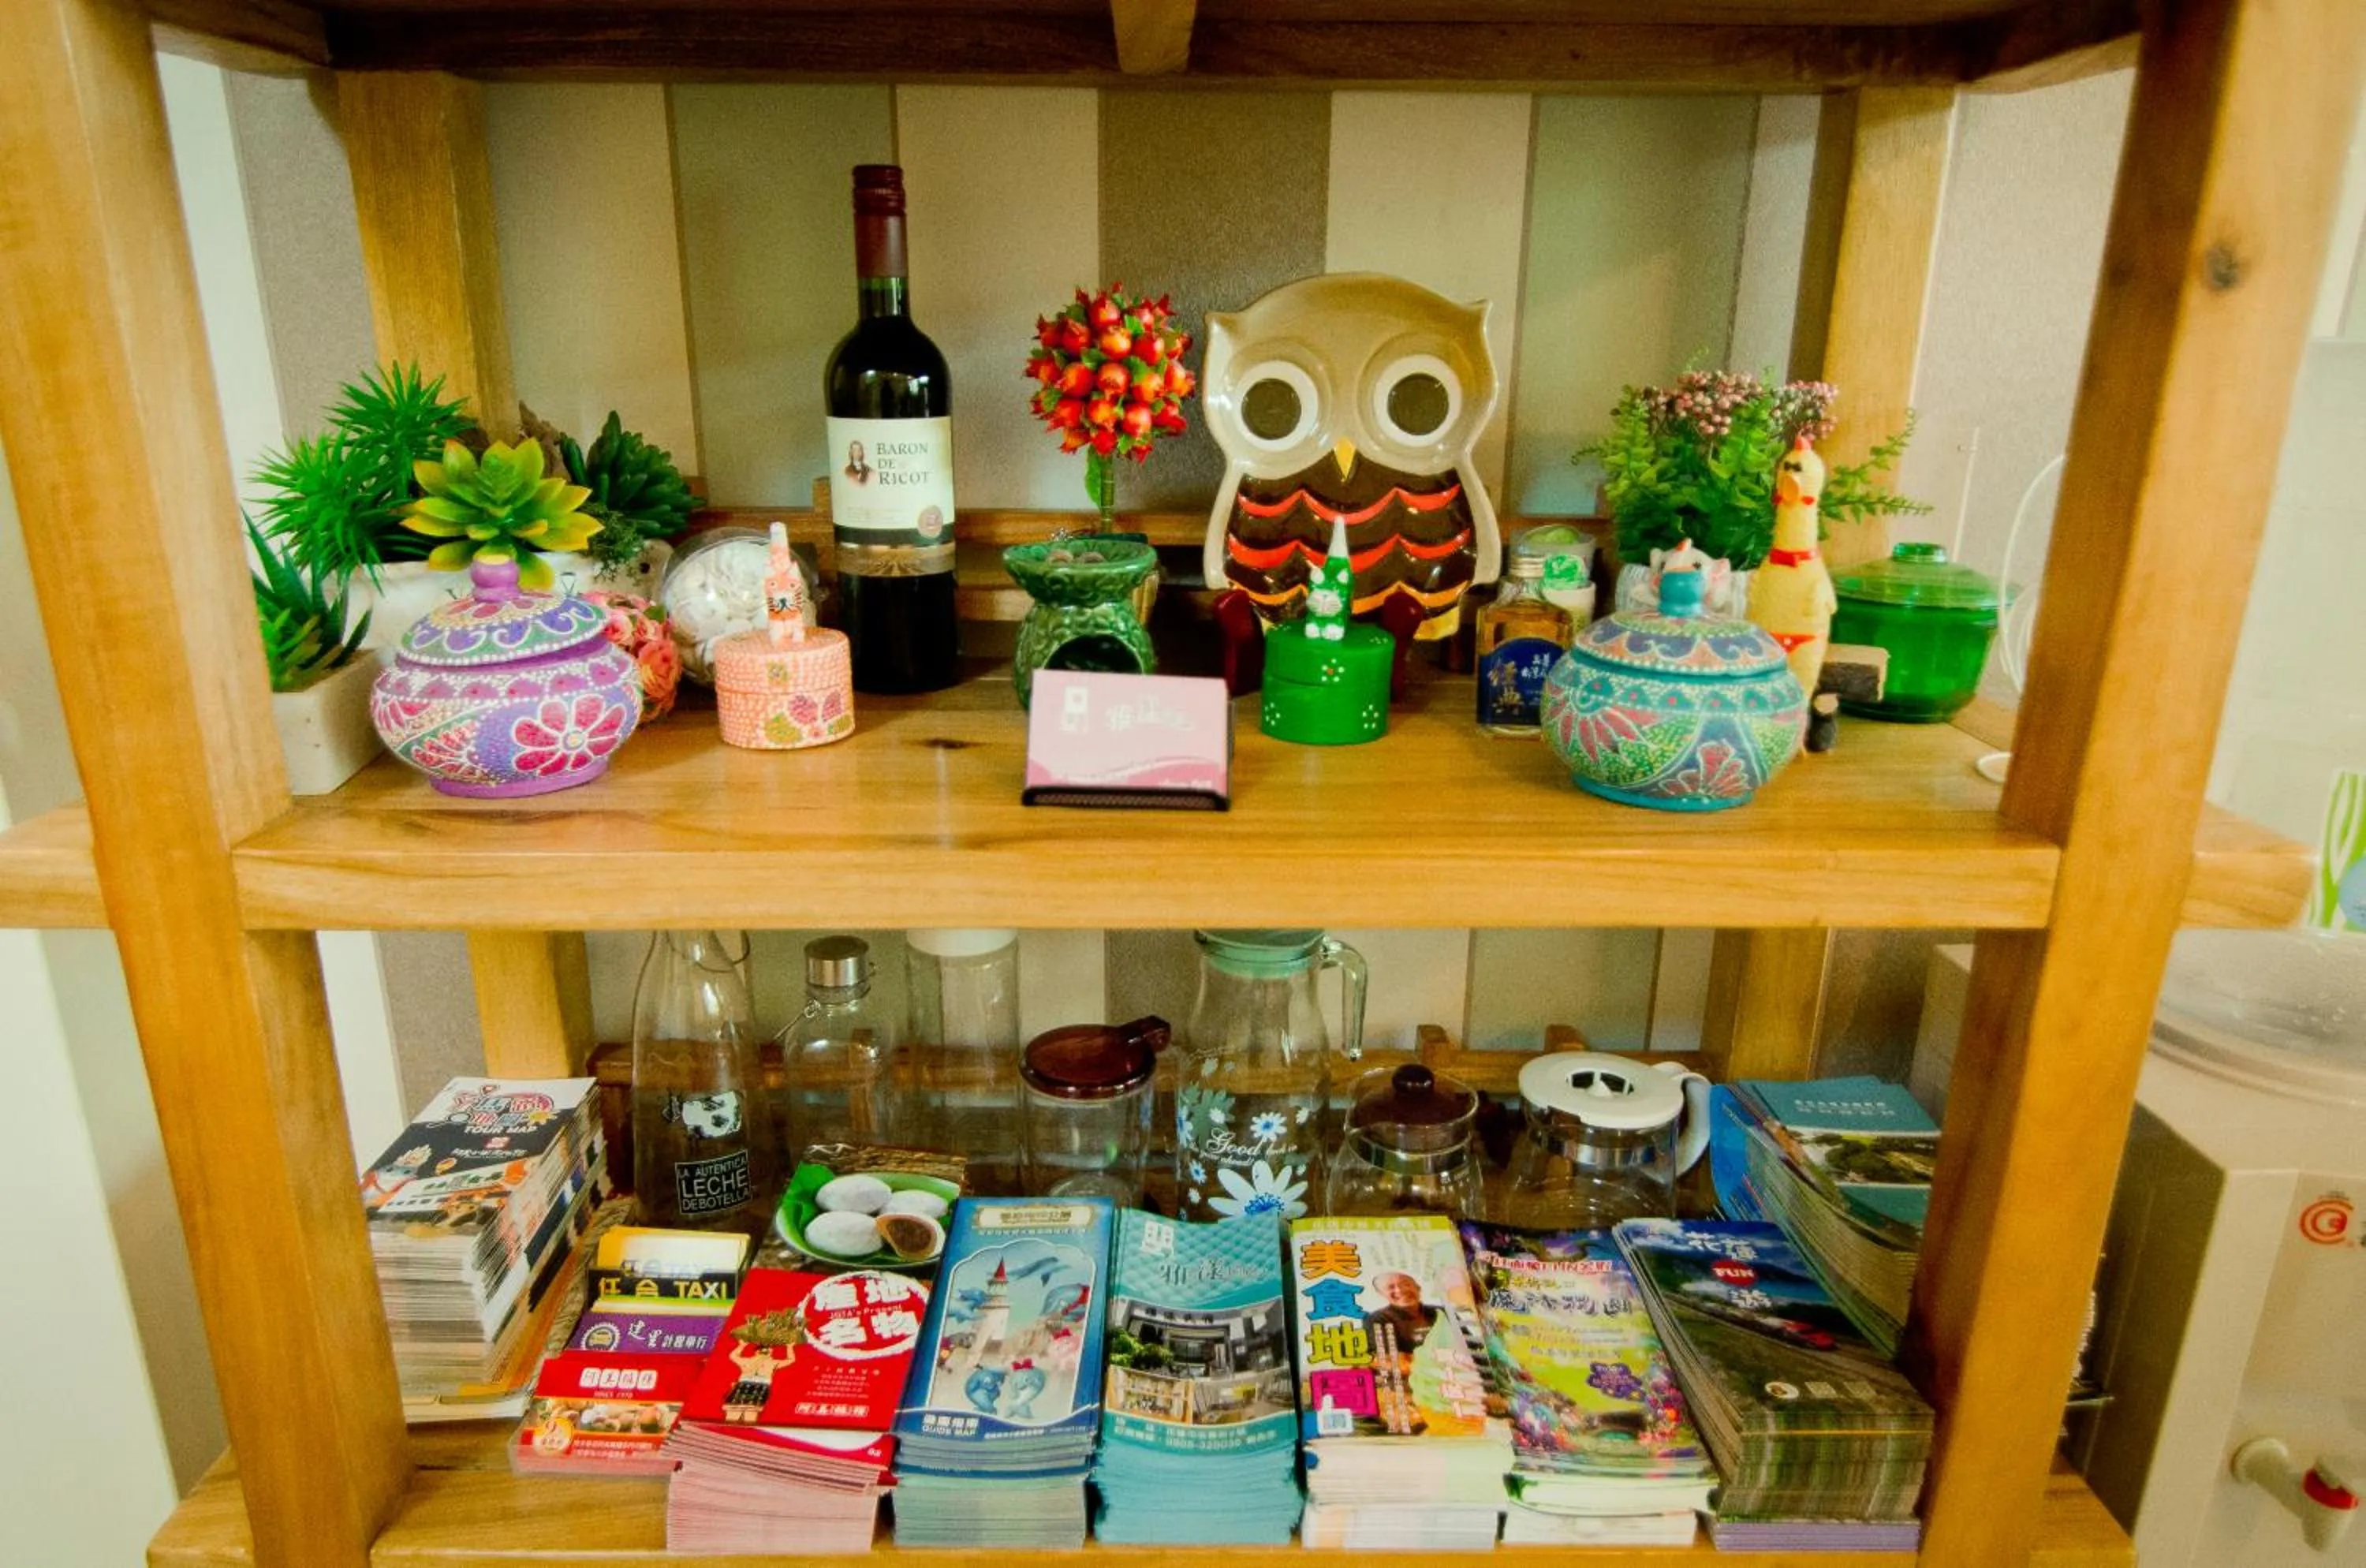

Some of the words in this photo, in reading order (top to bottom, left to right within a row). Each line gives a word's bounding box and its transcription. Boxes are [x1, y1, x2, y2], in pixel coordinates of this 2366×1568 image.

[876, 442, 928, 455] BARON
[878, 458, 895, 469] DE
[879, 471, 931, 485] RICOT
[1207, 1128, 1263, 1155] Good
[678, 1168, 689, 1178] LA
[682, 1168, 748, 1198] LECHE
[674, 1281, 728, 1299] TAXI
[1301, 1239, 1379, 1417] 美食地圖
